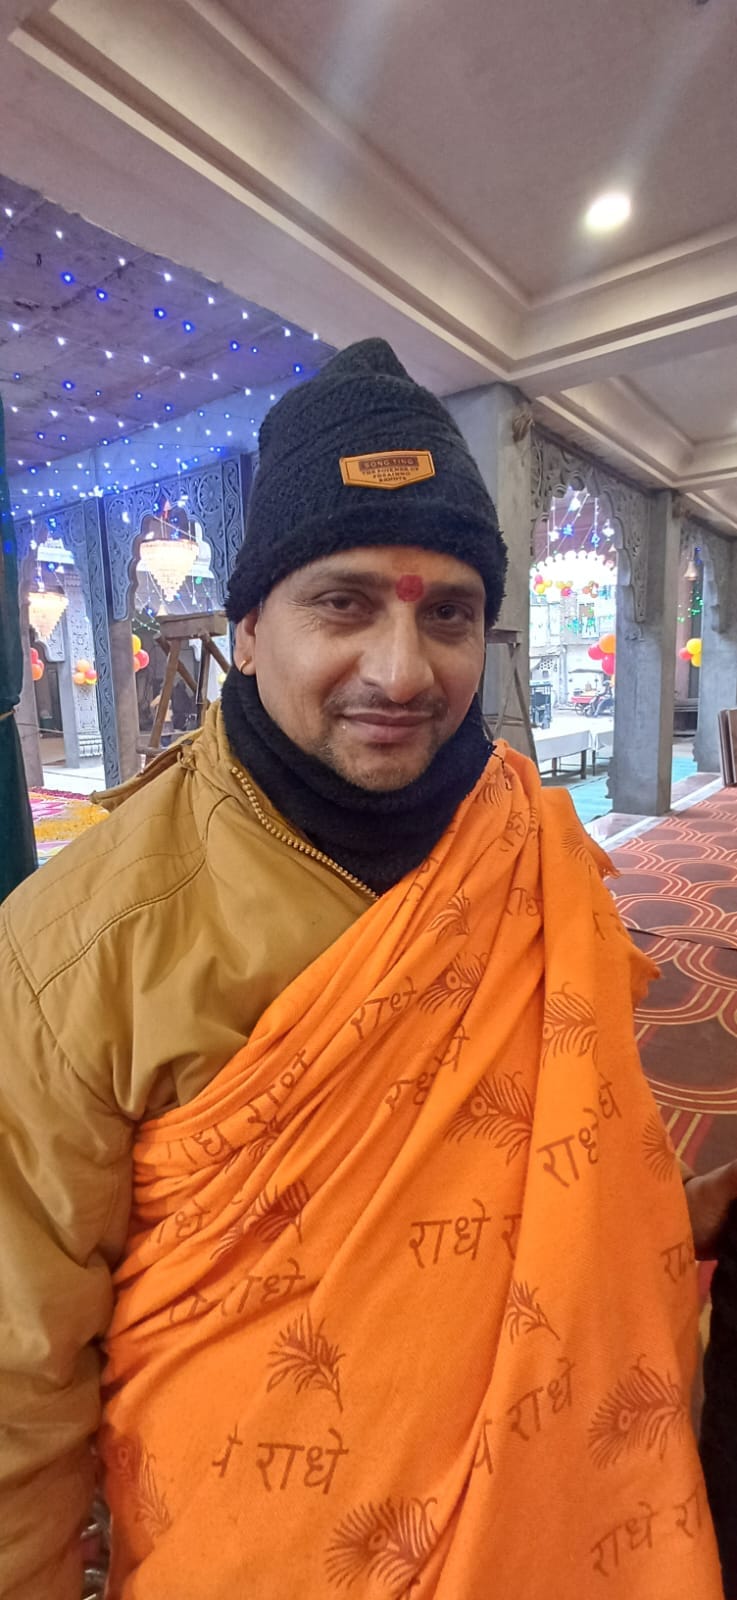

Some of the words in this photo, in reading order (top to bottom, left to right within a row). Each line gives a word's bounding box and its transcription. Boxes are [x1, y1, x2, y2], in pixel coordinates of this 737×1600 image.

[408, 1198, 492, 1270] राधे
[507, 1356, 576, 1442] राधे
[256, 1427, 350, 1495] राधे
[590, 1500, 659, 1578] राधे
